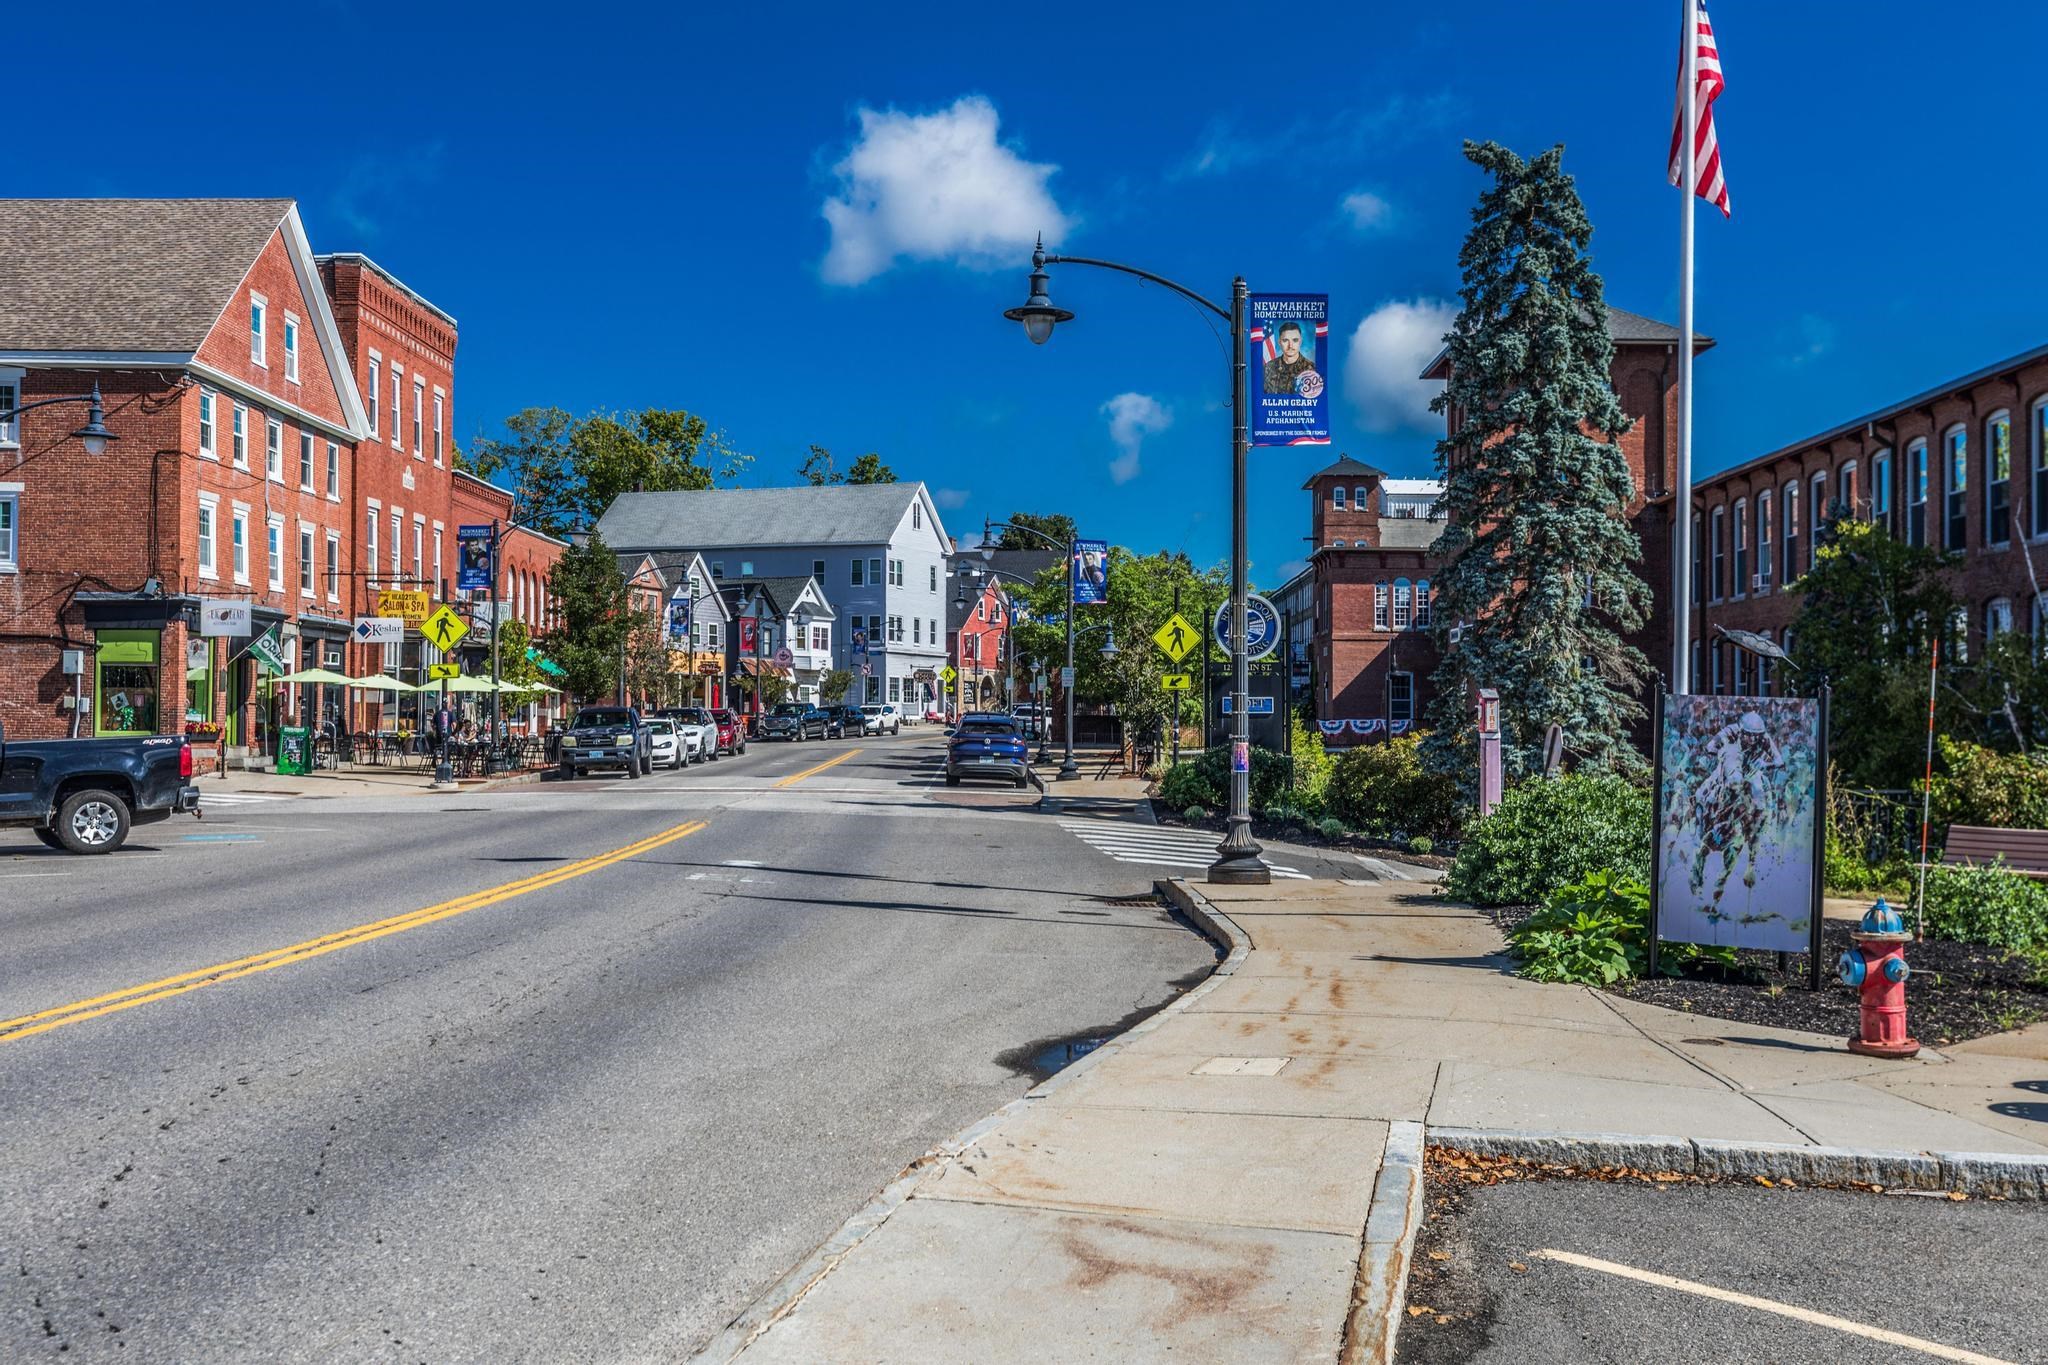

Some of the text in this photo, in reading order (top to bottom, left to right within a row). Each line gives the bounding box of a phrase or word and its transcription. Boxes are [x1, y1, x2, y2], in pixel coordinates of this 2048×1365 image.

[1253, 301, 1326, 311] NEWMARKET
[1253, 311, 1326, 319] HOMETOWN HERO
[1261, 398, 1318, 407] ALLAN GEARY
[383, 600, 405, 611] SALON
[411, 600, 425, 612] SPA
[372, 623, 402, 636] Keslar
